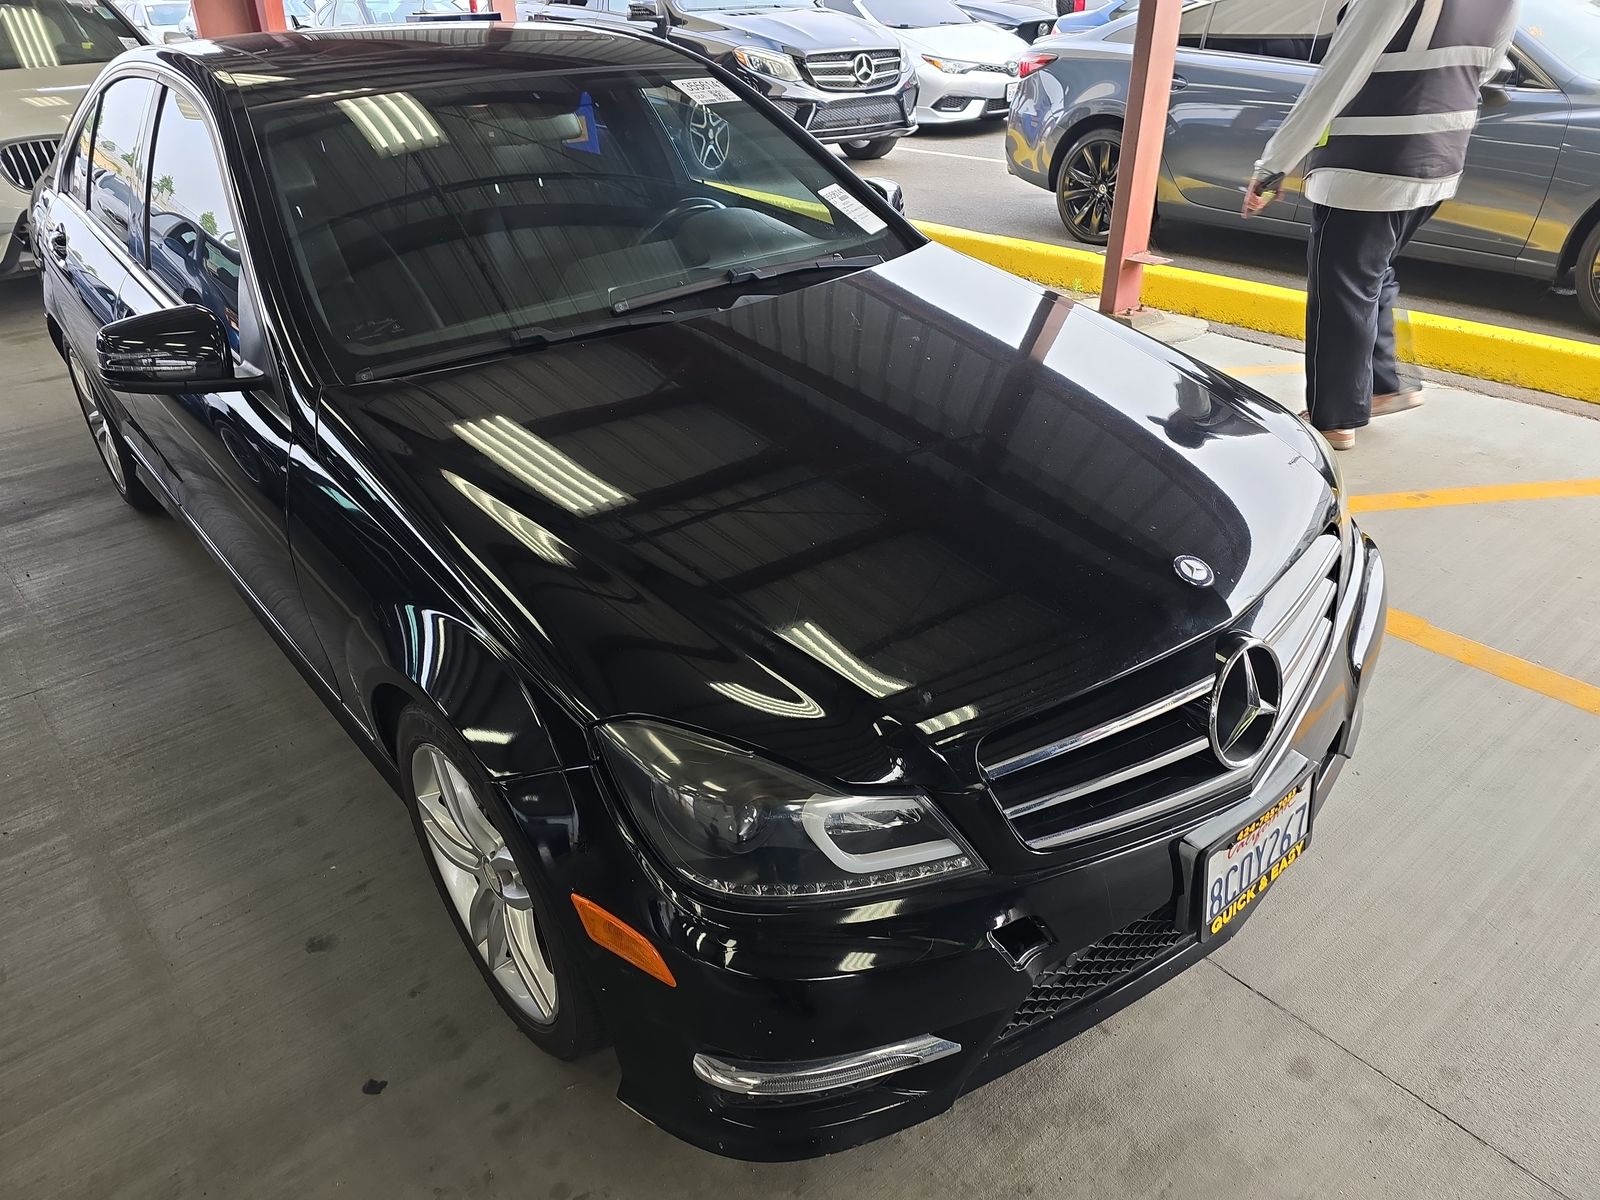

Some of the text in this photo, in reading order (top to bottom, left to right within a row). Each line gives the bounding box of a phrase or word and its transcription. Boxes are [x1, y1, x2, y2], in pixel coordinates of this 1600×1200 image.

[1210, 839, 1305, 934] QUICK & EASY
